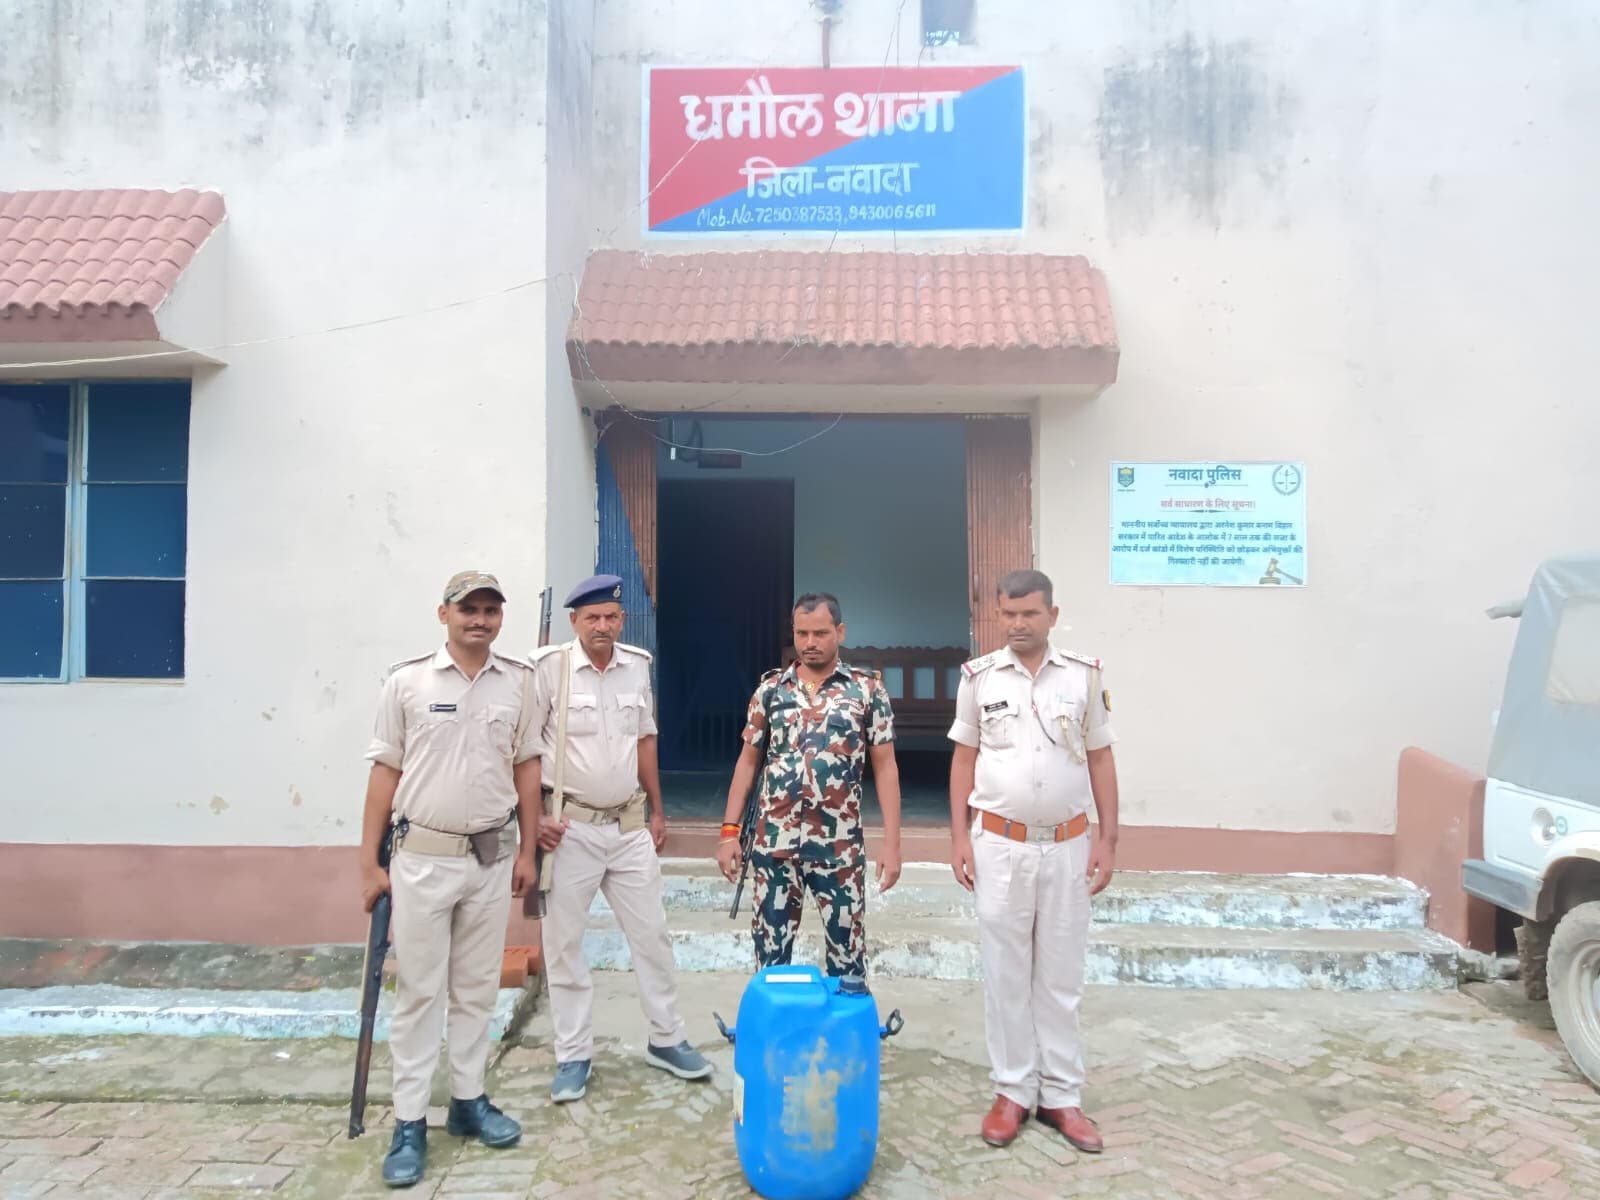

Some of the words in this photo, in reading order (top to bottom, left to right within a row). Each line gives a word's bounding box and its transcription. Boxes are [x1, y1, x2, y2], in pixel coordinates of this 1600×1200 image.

[679, 75, 825, 141] धमौल
[833, 91, 962, 139] थाना
[738, 156, 921, 198] जिला-नवादा
[1168, 468, 1204, 481] नवादा
[1206, 465, 1242, 485] पुलिस
[1205, 498, 1213, 508] के
